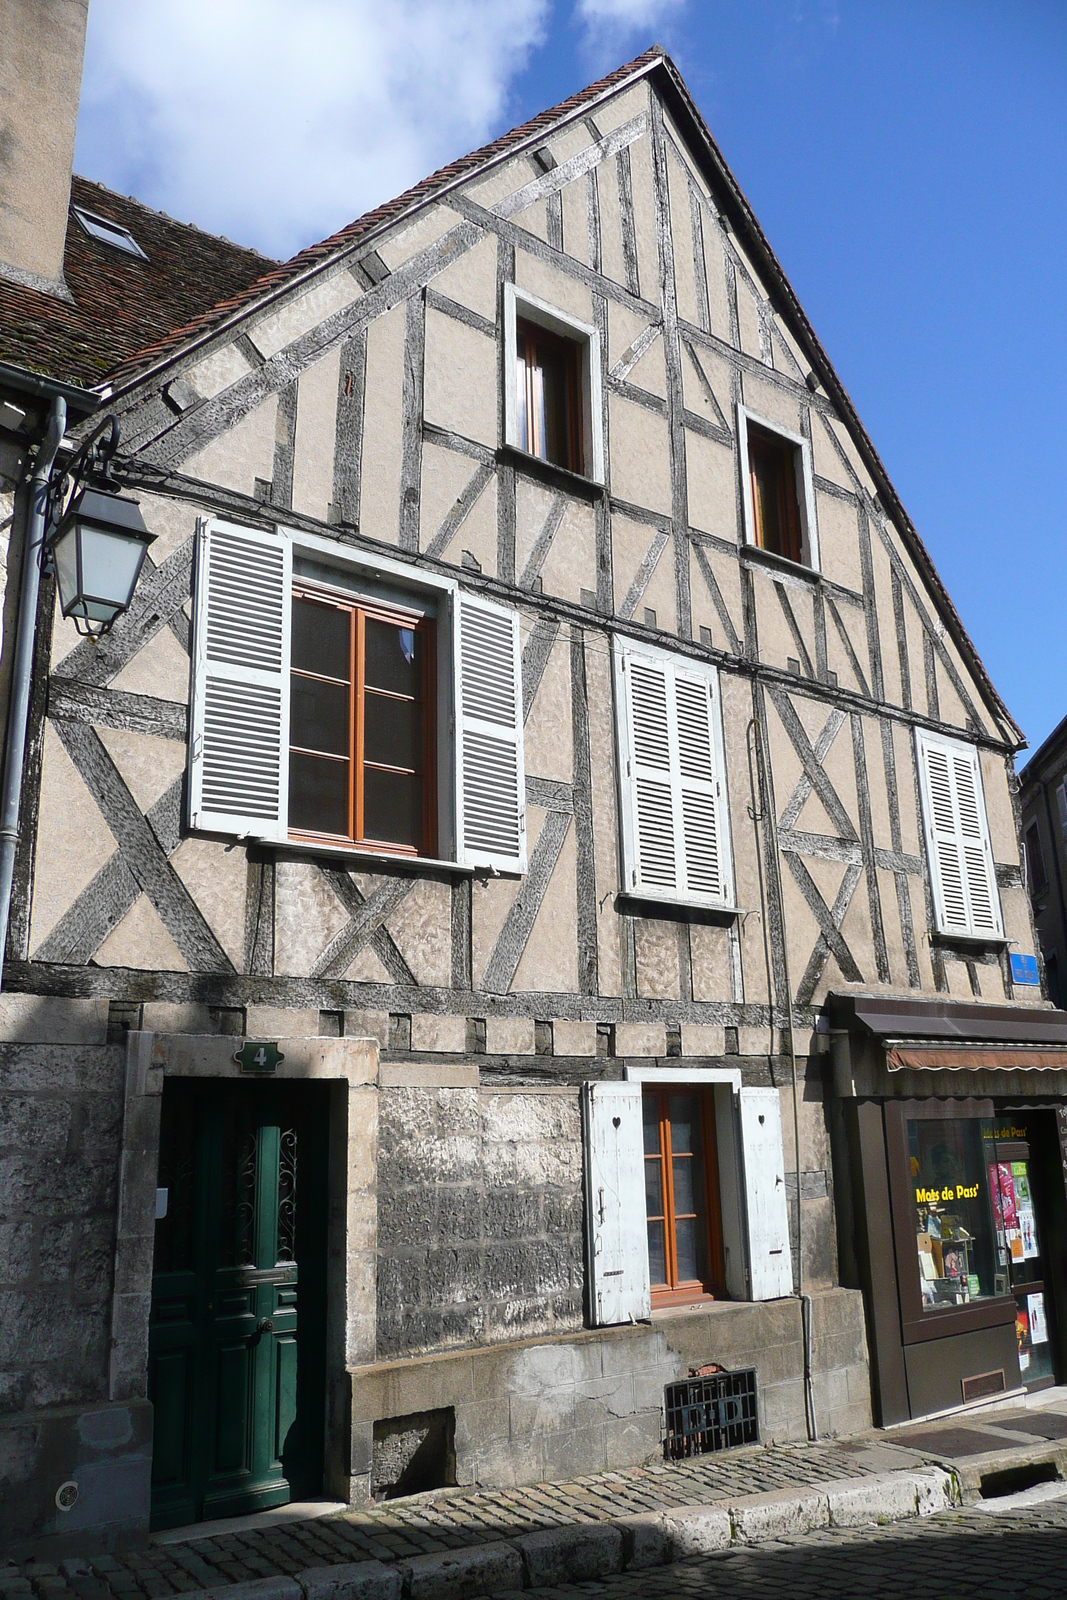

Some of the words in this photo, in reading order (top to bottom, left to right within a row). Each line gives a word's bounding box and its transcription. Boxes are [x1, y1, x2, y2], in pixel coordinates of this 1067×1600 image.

[253, 1047, 267, 1066] 4
[1001, 1127, 1010, 1138] de
[916, 1188, 940, 1203] Mots
[941, 1186, 954, 1201] de
[956, 1183, 979, 1199] Pass'
